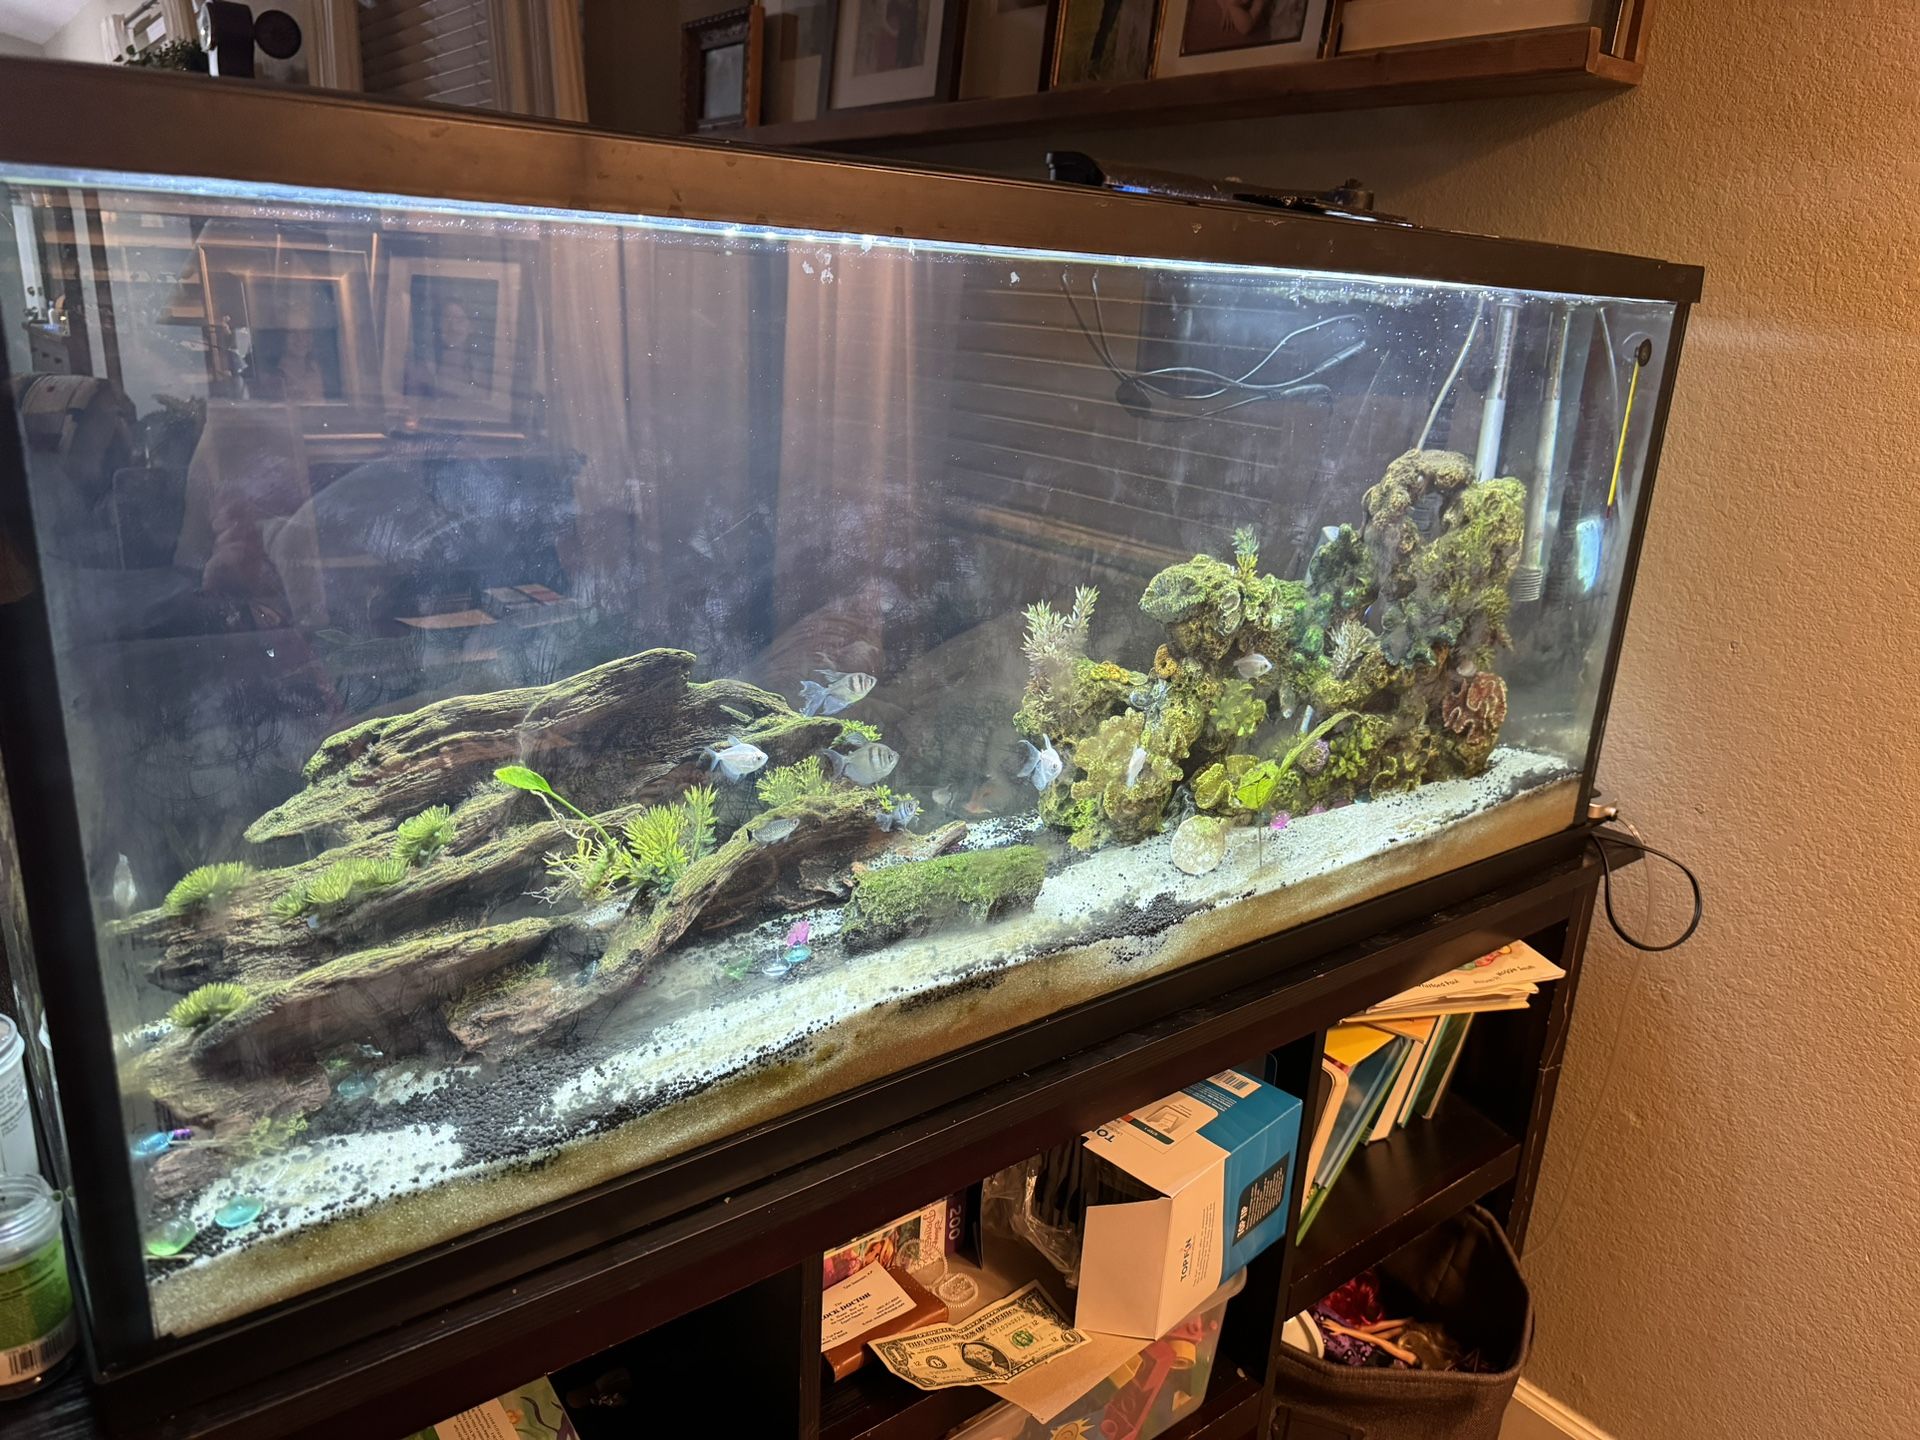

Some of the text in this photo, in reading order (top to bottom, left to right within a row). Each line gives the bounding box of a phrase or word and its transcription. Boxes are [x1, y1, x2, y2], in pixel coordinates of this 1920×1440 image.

[948, 1204, 962, 1241] 200
[822, 1308, 841, 1321] OCK
[840, 1292, 871, 1311] DOCTOR
